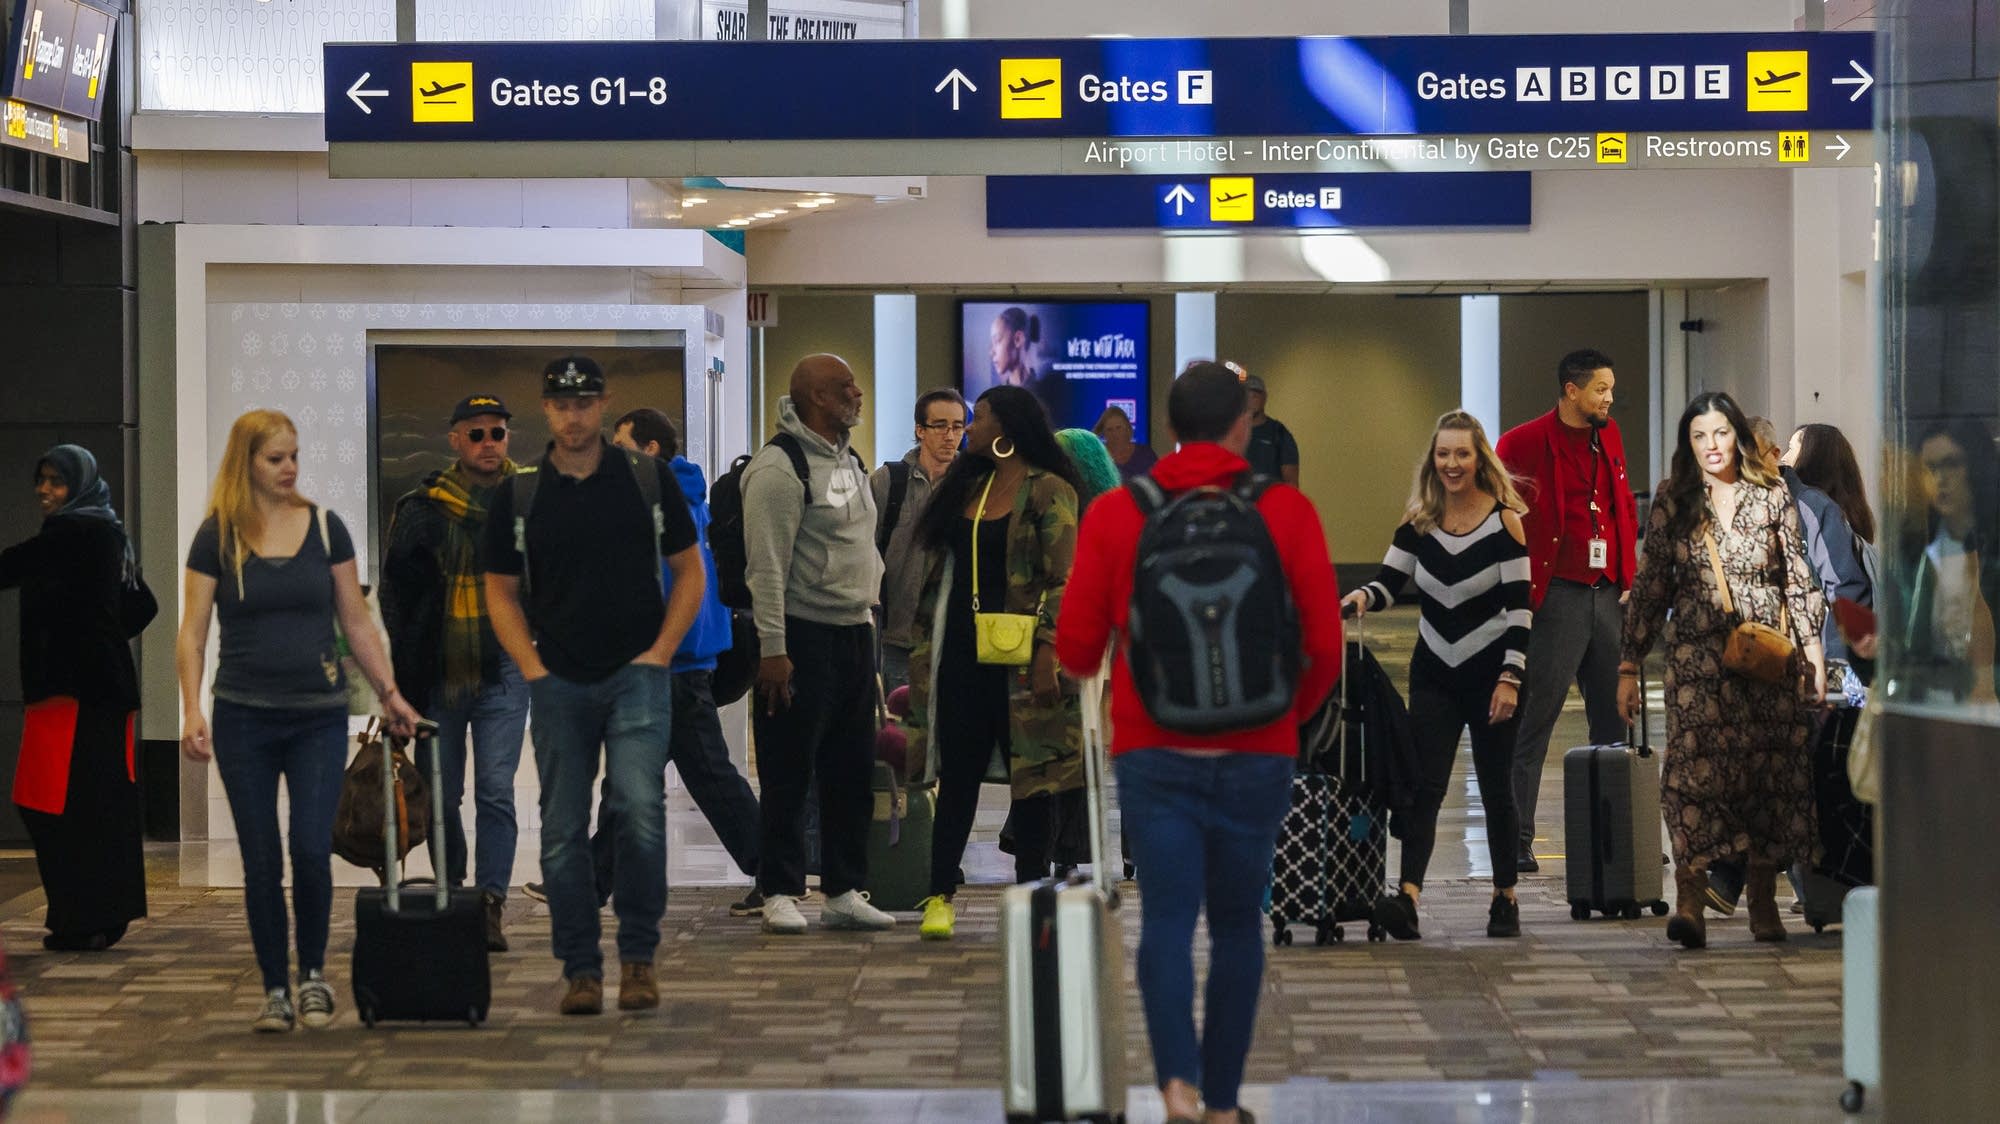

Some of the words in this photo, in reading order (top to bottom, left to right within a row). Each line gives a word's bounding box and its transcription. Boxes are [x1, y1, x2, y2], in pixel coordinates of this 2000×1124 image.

[717, 10, 748, 40] SHAR
[769, 15, 789, 40] THE
[795, 17, 857, 40] CREATIVITY
[491, 77, 579, 106] Gates
[1079, 74, 1168, 103] Gates
[1187, 75, 1204, 99] F
[1417, 72, 1506, 100] Gates
[1523, 72, 1544, 97] A
[1569, 71, 1588, 96] B
[1614, 70, 1632, 96] C
[1658, 70, 1677, 95] D
[1704, 70, 1721, 94] E
[1084, 141, 1167, 168] Airport
[1176, 140, 1236, 162] Hotel
[1262, 138, 1447, 161] InterContinental
[1455, 138, 1480, 165] by
[1488, 137, 1539, 159] Gate
[1547, 137, 1590, 159] C25
[1647, 136, 1772, 157] Restrooms
[1264, 190, 1316, 208] Gates
[1325, 192, 1336, 205] F
